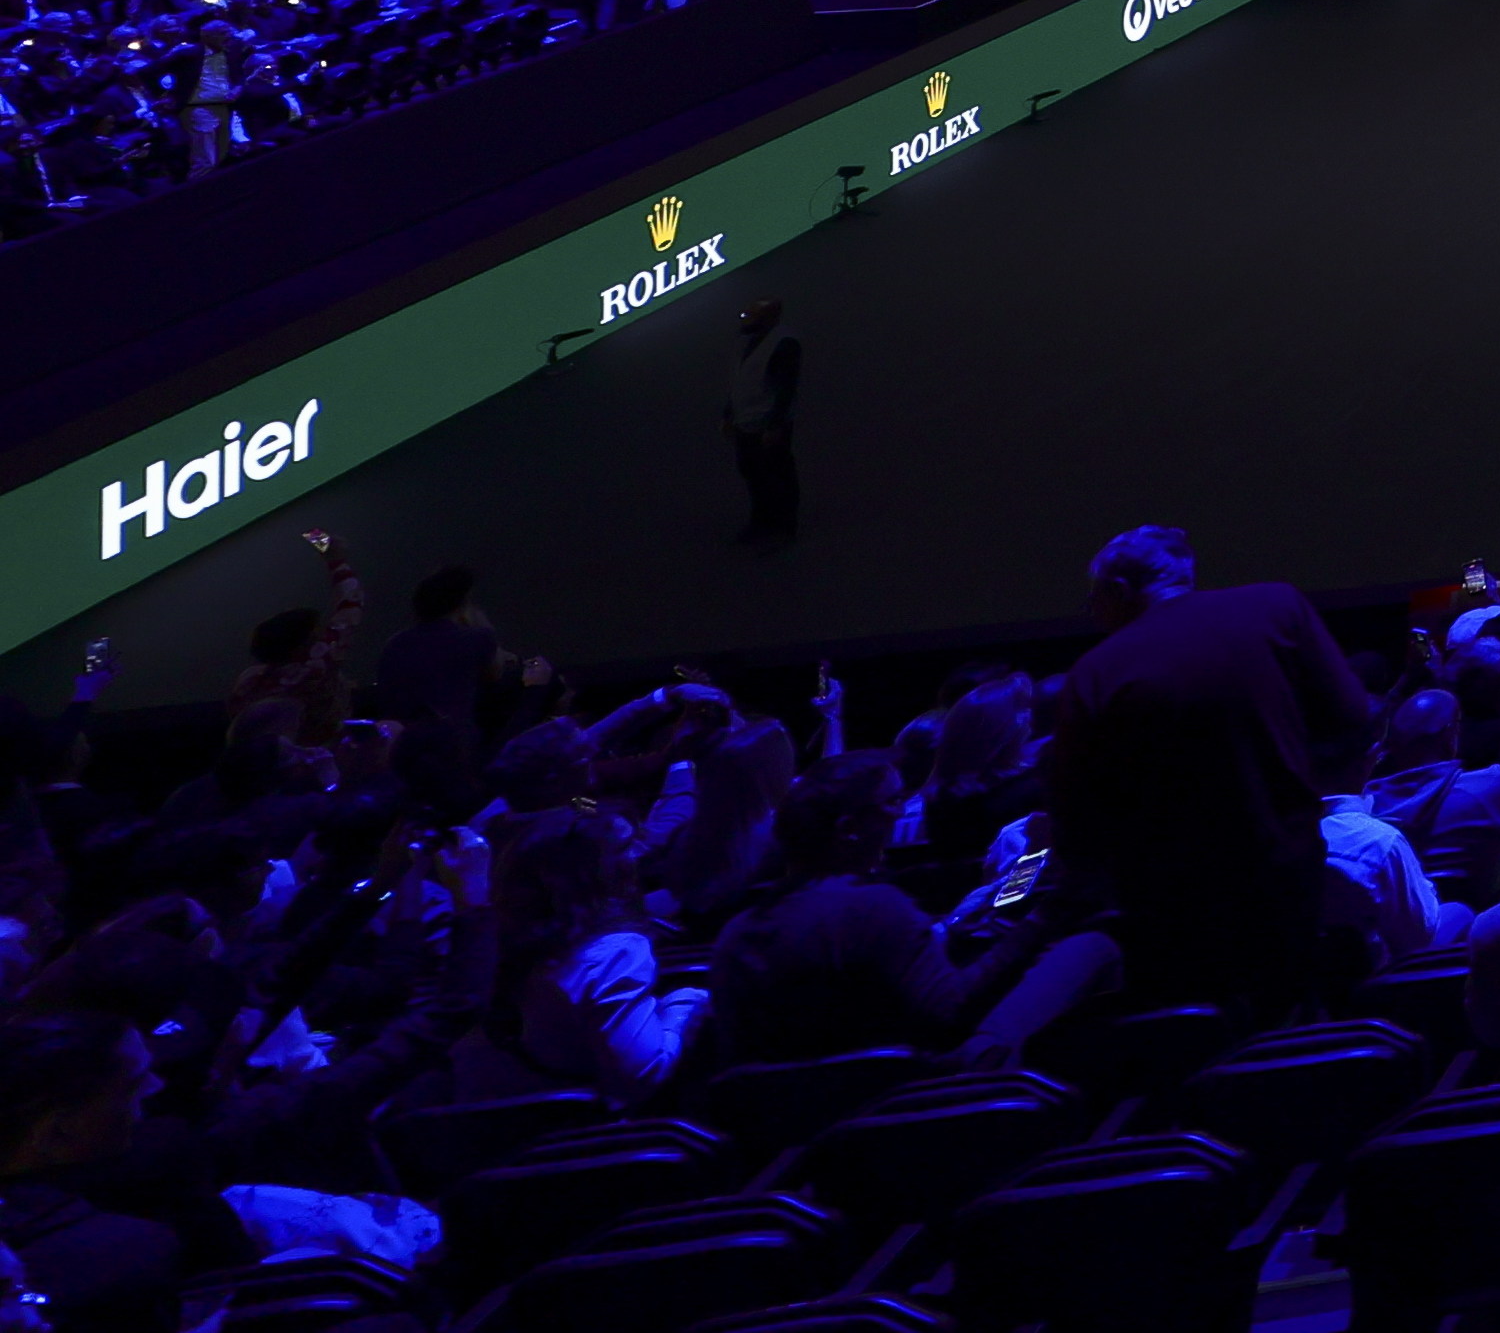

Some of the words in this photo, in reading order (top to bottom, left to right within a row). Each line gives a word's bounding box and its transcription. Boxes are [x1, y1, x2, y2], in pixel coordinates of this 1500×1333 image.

[890, 106, 981, 175] ROLEX
[601, 233, 725, 324] ROLEX
[100, 398, 320, 560] Haier
